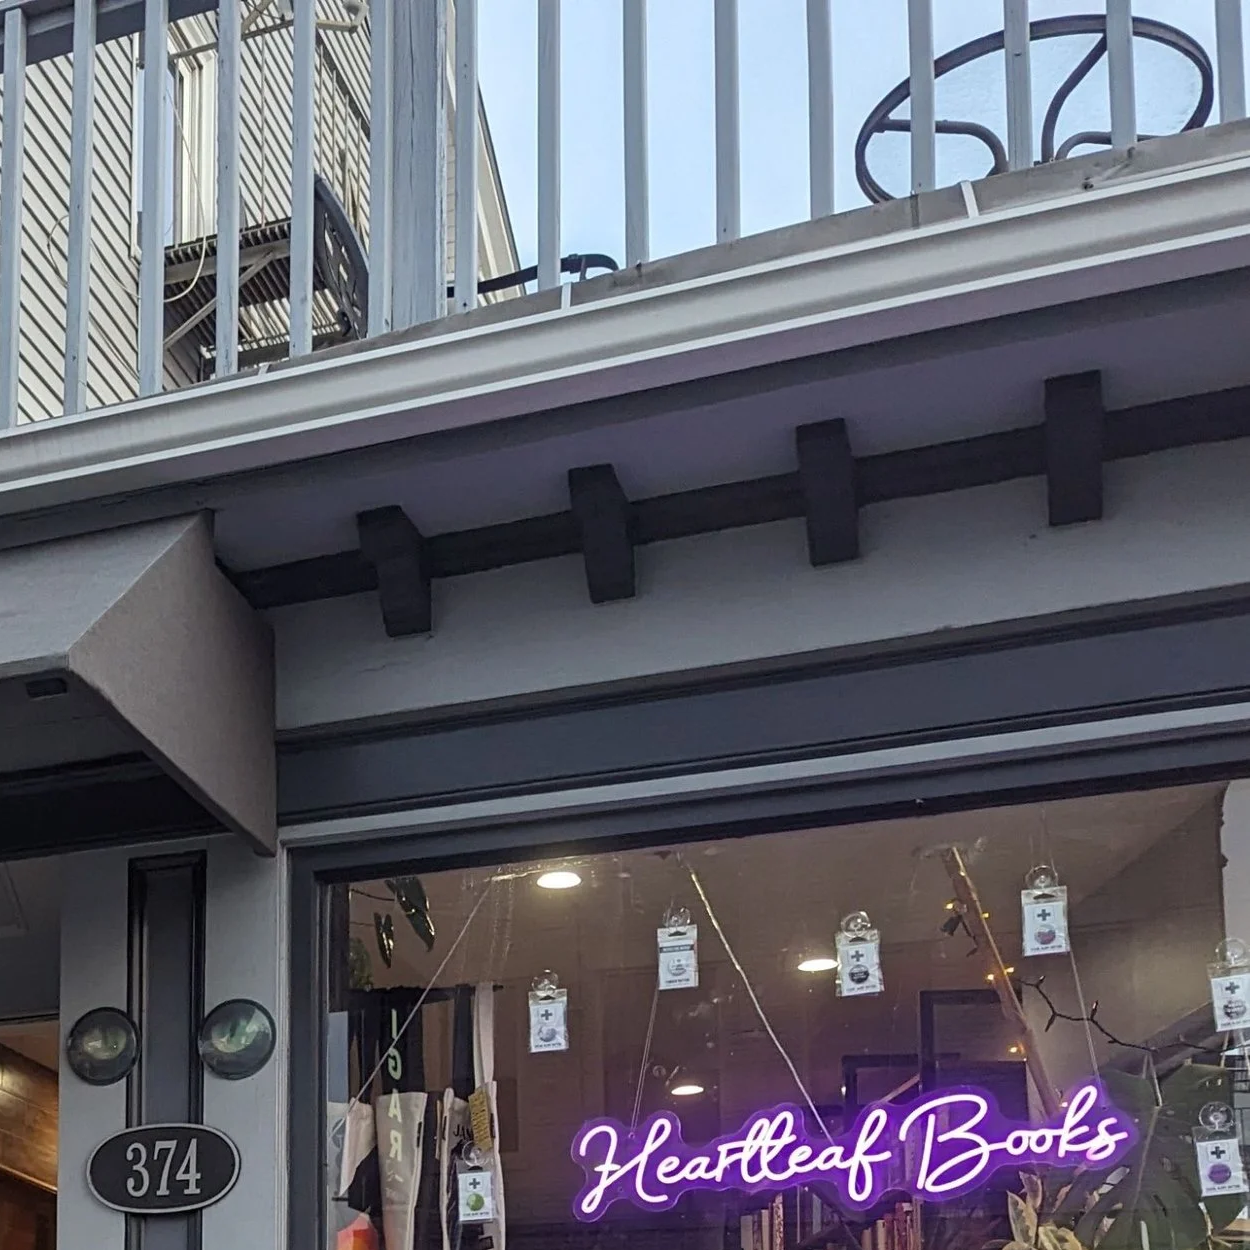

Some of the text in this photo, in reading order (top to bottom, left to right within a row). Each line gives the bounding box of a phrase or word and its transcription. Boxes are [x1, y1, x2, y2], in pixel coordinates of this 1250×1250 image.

[126, 1138, 202, 1198] 374
[579, 1084, 1128, 1214] Heartleaf Books
